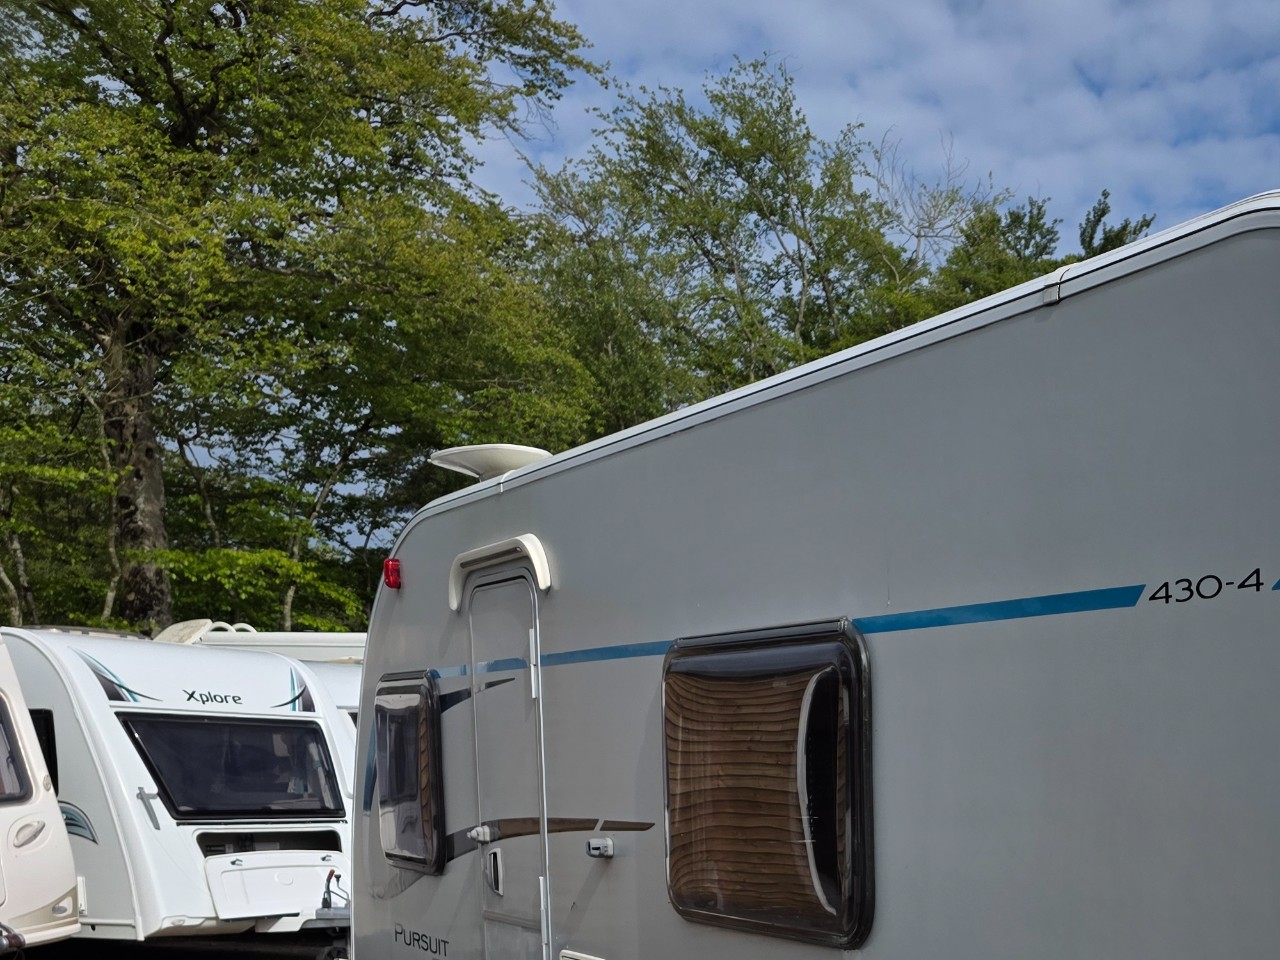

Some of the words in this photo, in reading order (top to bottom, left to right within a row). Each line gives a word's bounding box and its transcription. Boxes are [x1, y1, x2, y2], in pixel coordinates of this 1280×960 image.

[1148, 567, 1265, 605] 430-4
[182, 689, 243, 706] Xplore
[394, 922, 449, 957] PURSUIT
